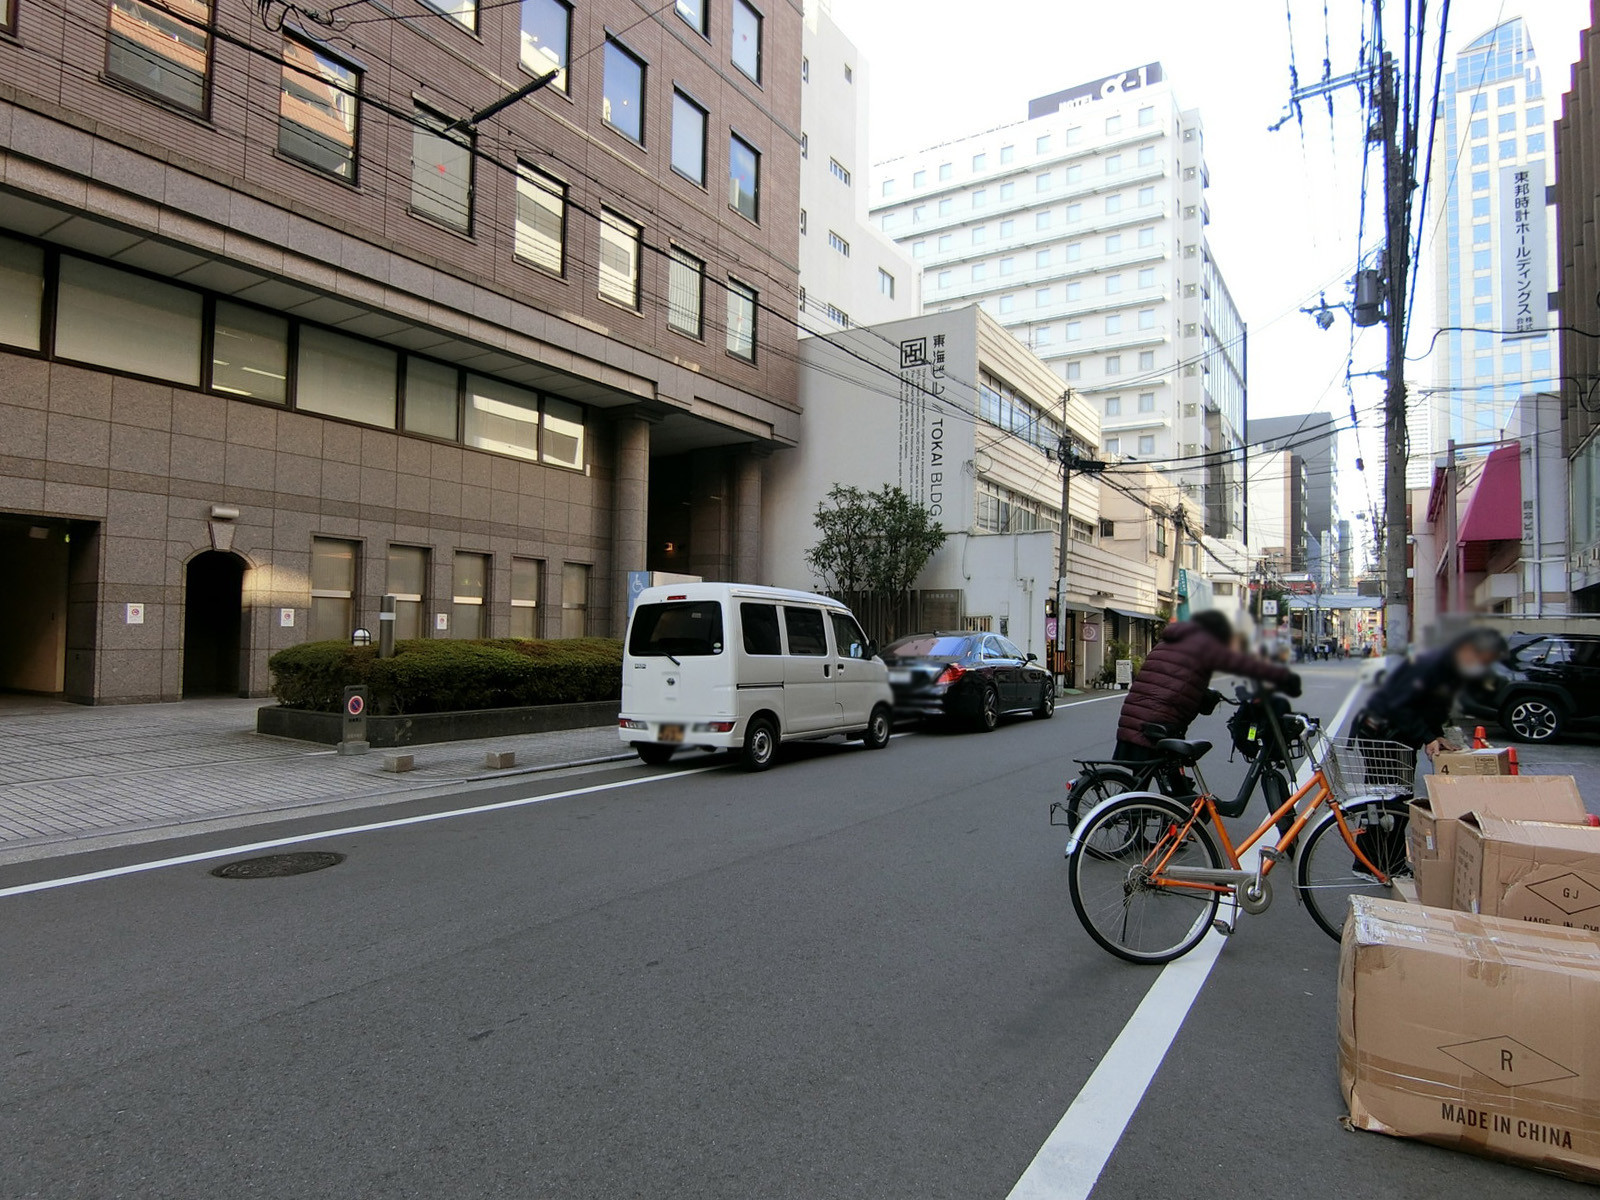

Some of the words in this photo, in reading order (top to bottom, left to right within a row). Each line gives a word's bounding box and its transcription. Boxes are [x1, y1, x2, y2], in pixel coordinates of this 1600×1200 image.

[1514, 170, 1531, 316] 東邦時計ホールディングス
[932, 334, 946, 395] 東海ビル
[931, 418, 943, 466] TOKAI
[1441, 764, 1450, 775] 4
[1500, 1049, 1513, 1072] R
[1441, 1102, 1488, 1129] MADE
[1493, 1114, 1511, 1135] IN
[1517, 1120, 1573, 1149] CHINA
